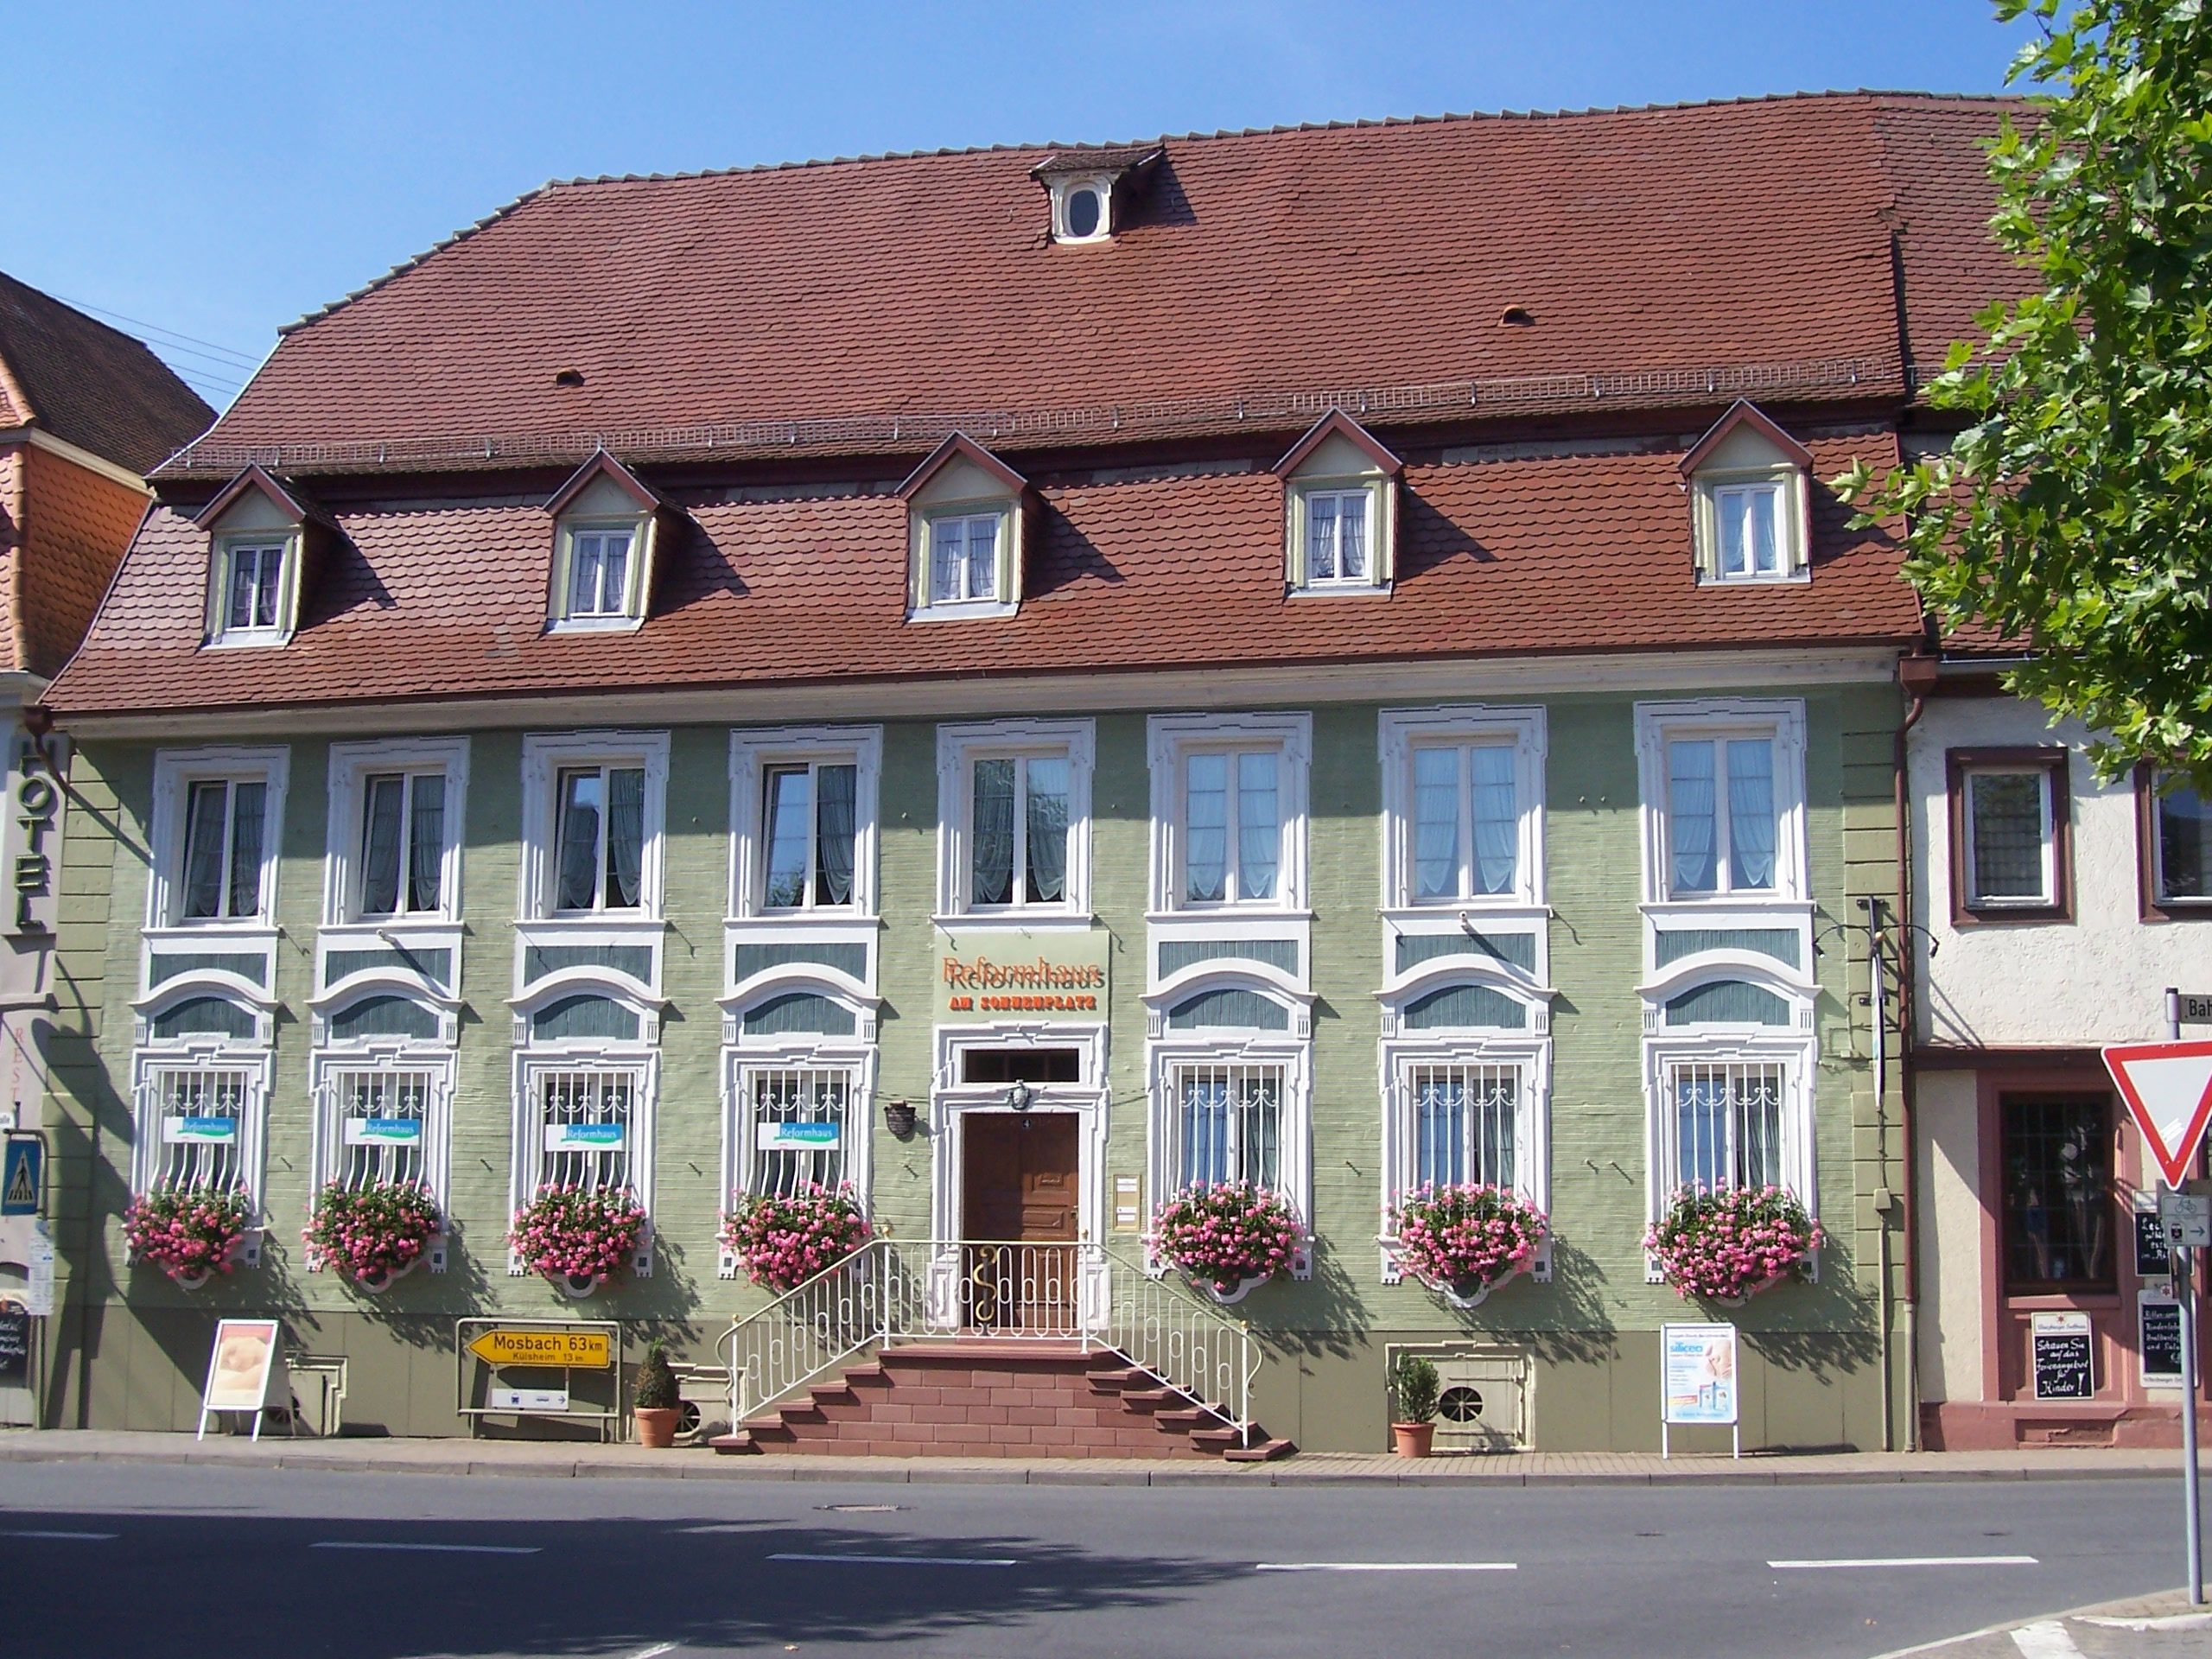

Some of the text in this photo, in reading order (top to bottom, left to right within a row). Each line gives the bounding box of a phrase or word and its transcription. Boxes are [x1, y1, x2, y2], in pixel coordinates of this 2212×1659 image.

[16, 740, 54, 927] HOTEL
[943, 956, 1103, 986] Reformhaus
[950, 995, 1096, 1009] AM SONNENPLATZ
[183, 1122, 231, 1133] Reformhaus
[365, 1122, 415, 1135] Reformhaus
[780, 1127, 833, 1140] Reformhaus
[567, 1128, 617, 1141] Reformhaus
[494, 1335, 603, 1351] Mosbach 63 km
[2037, 1339, 2069, 1351] Schauen
[512, 1351, 556, 1362] Külsheim
[563, 1353, 574, 1362] 13
